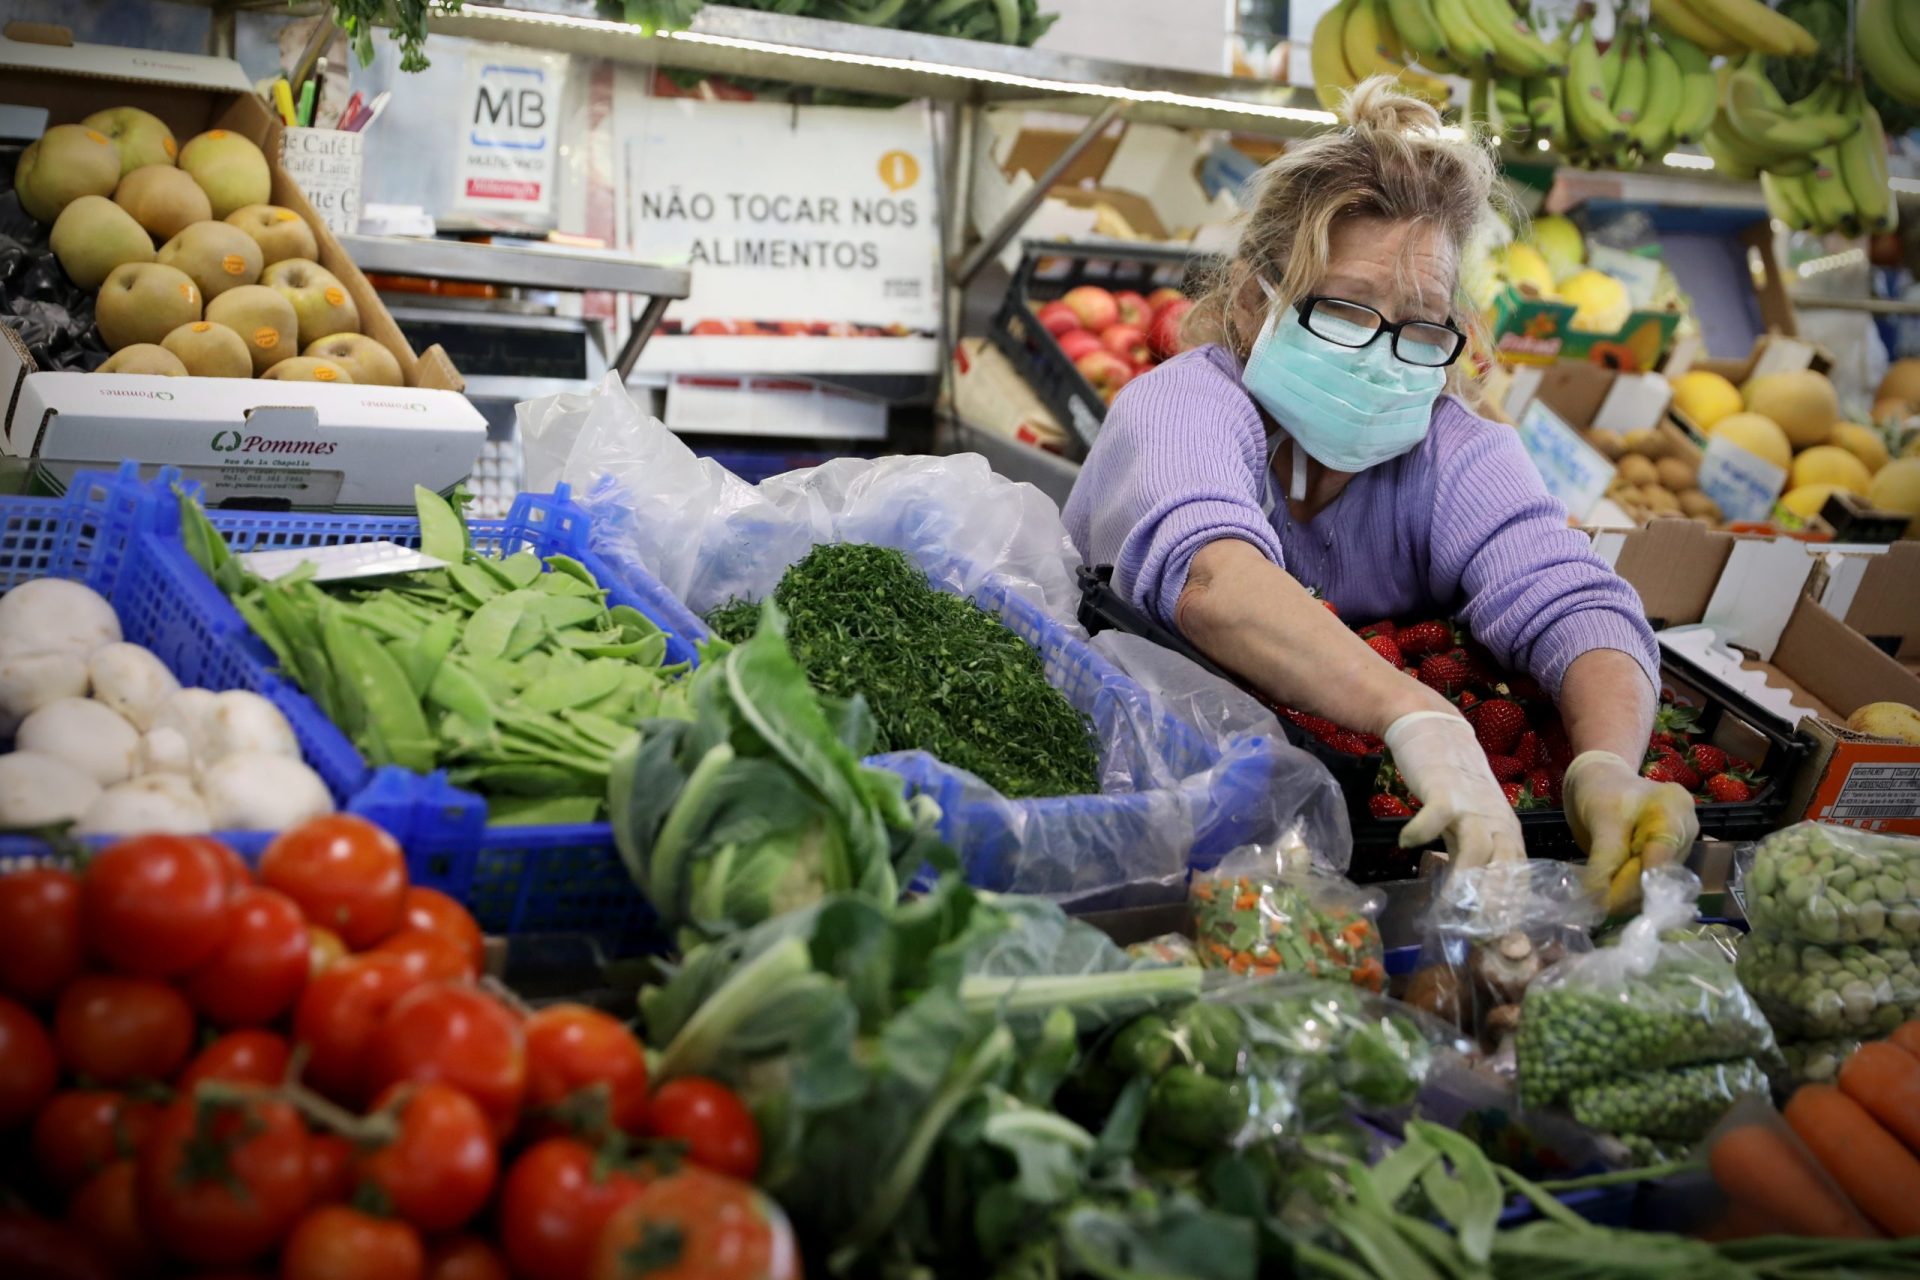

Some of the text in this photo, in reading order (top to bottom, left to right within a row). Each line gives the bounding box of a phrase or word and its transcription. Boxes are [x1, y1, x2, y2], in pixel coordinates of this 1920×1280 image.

[474, 86, 545, 128] MB
[641, 185, 918, 226] NÃO TOCAR NOS
[687, 239, 879, 269] ALIMENTOS
[242, 435, 338, 455] Pommes
